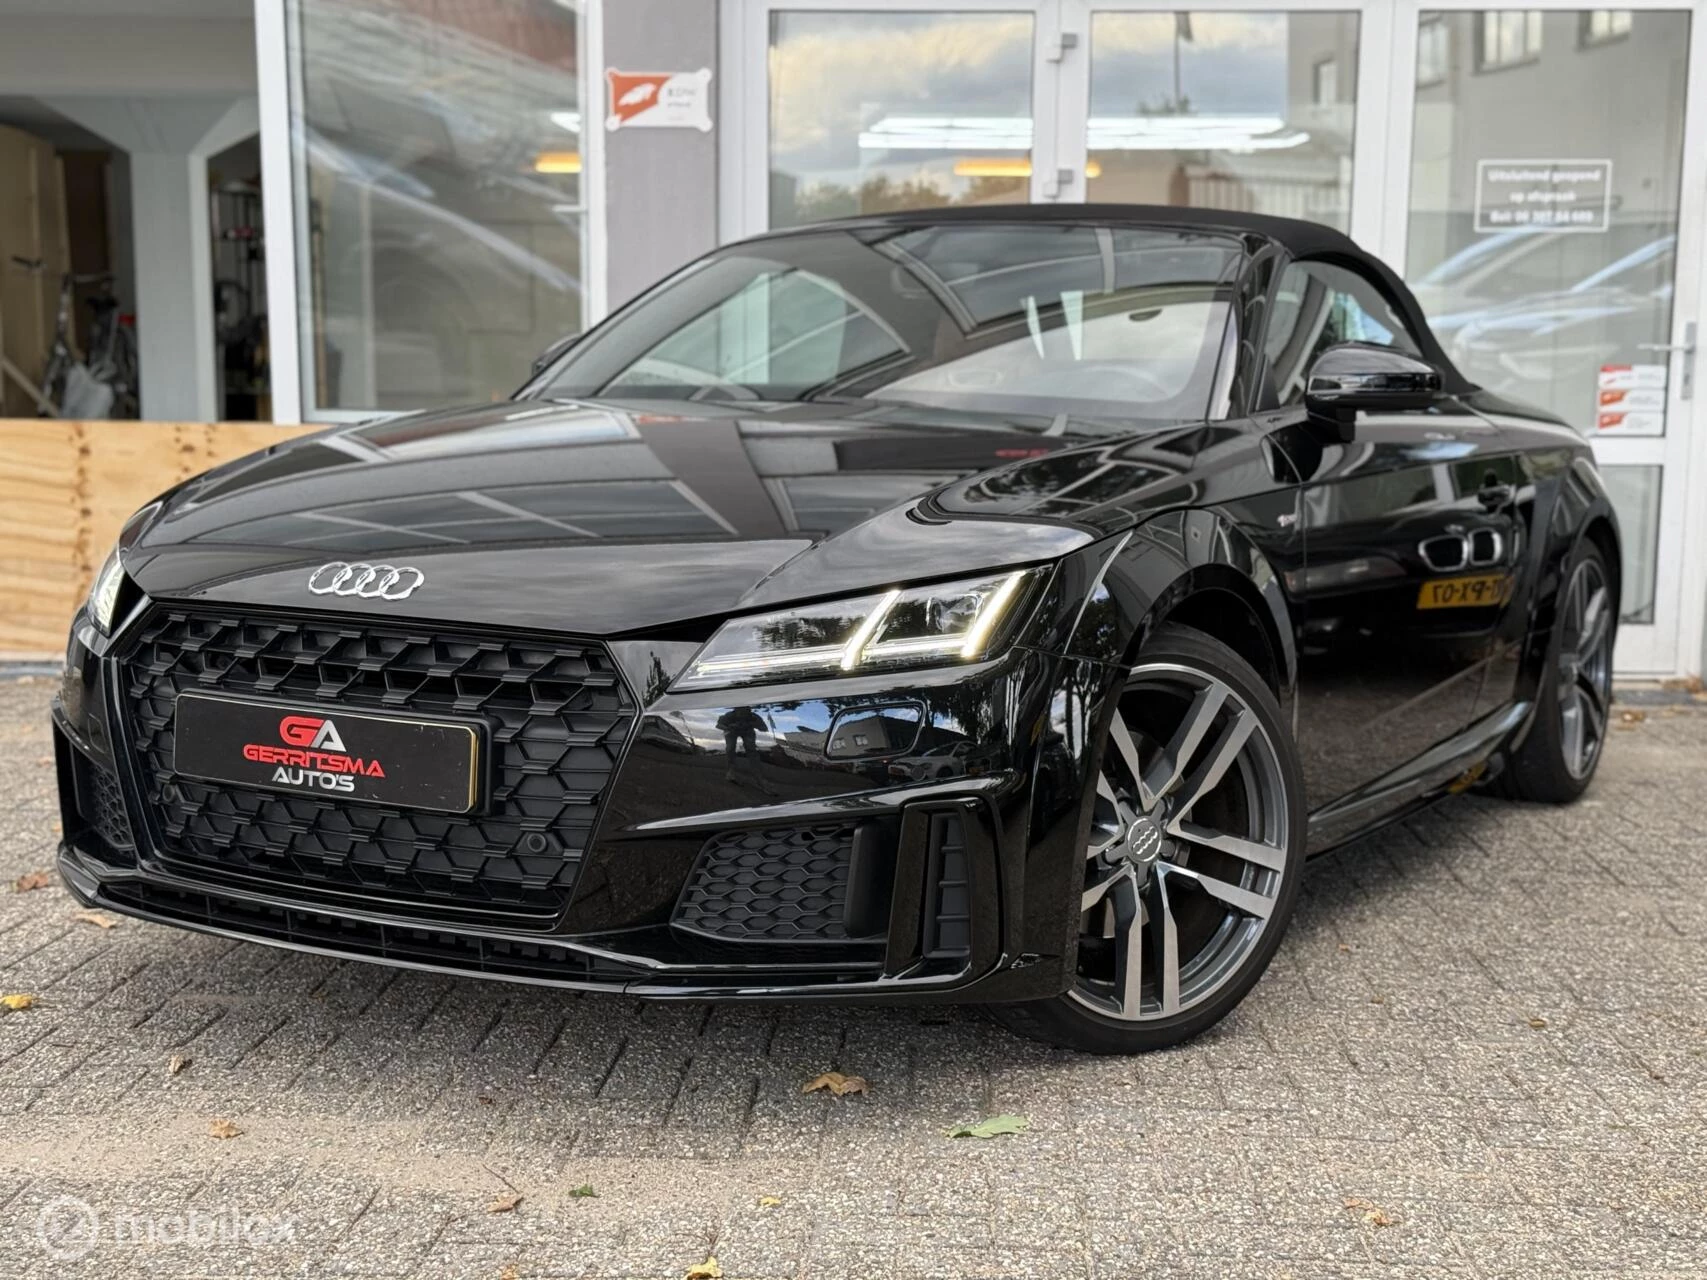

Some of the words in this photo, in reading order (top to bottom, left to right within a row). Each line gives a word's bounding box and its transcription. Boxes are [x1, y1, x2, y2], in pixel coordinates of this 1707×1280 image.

[279, 715, 347, 753] GA
[242, 744, 386, 778] GERRITSMA
[271, 766, 355, 792] AUTO'S
